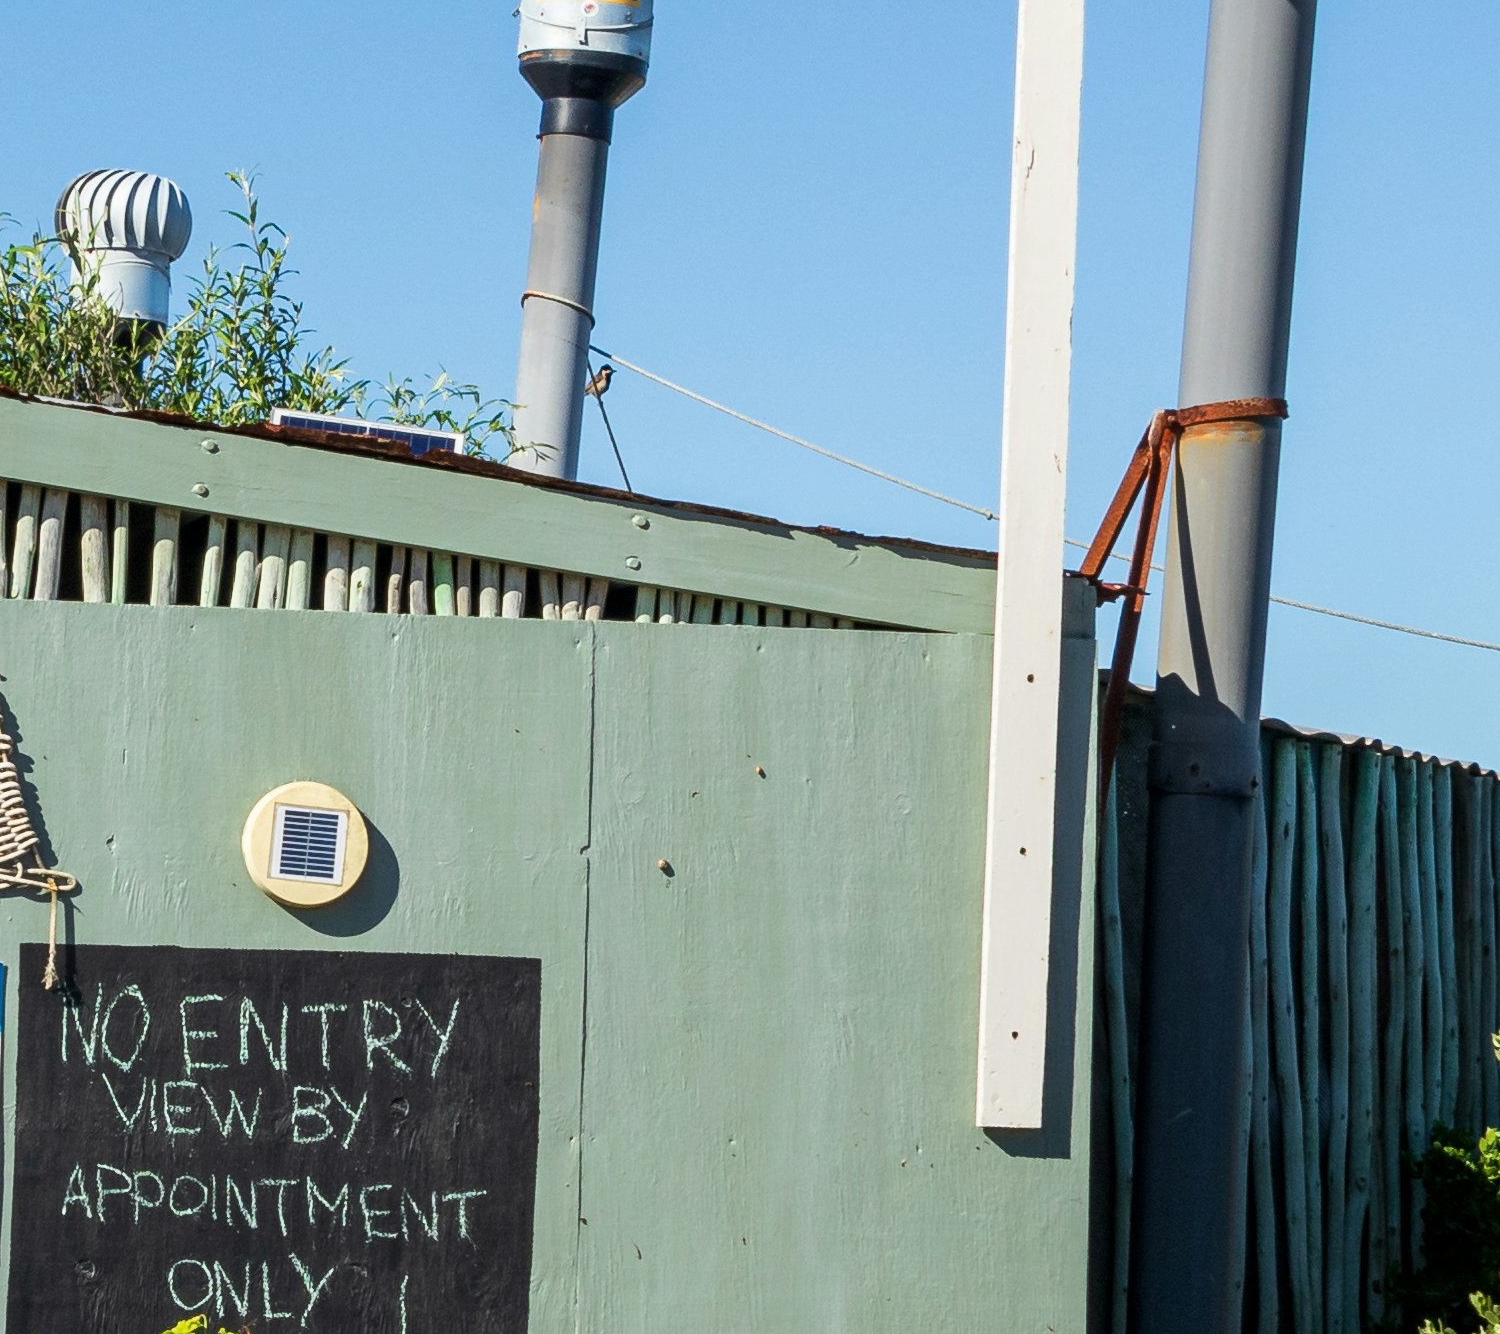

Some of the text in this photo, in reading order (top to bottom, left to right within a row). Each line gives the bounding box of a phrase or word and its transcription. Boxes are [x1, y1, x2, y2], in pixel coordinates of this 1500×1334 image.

[59, 983, 461, 1079] NO ENTRY
[102, 1073, 368, 1149] VIEW BY
[61, 1163, 488, 1251] APPOINTMENT
[167, 1255, 336, 1327] ONLY
